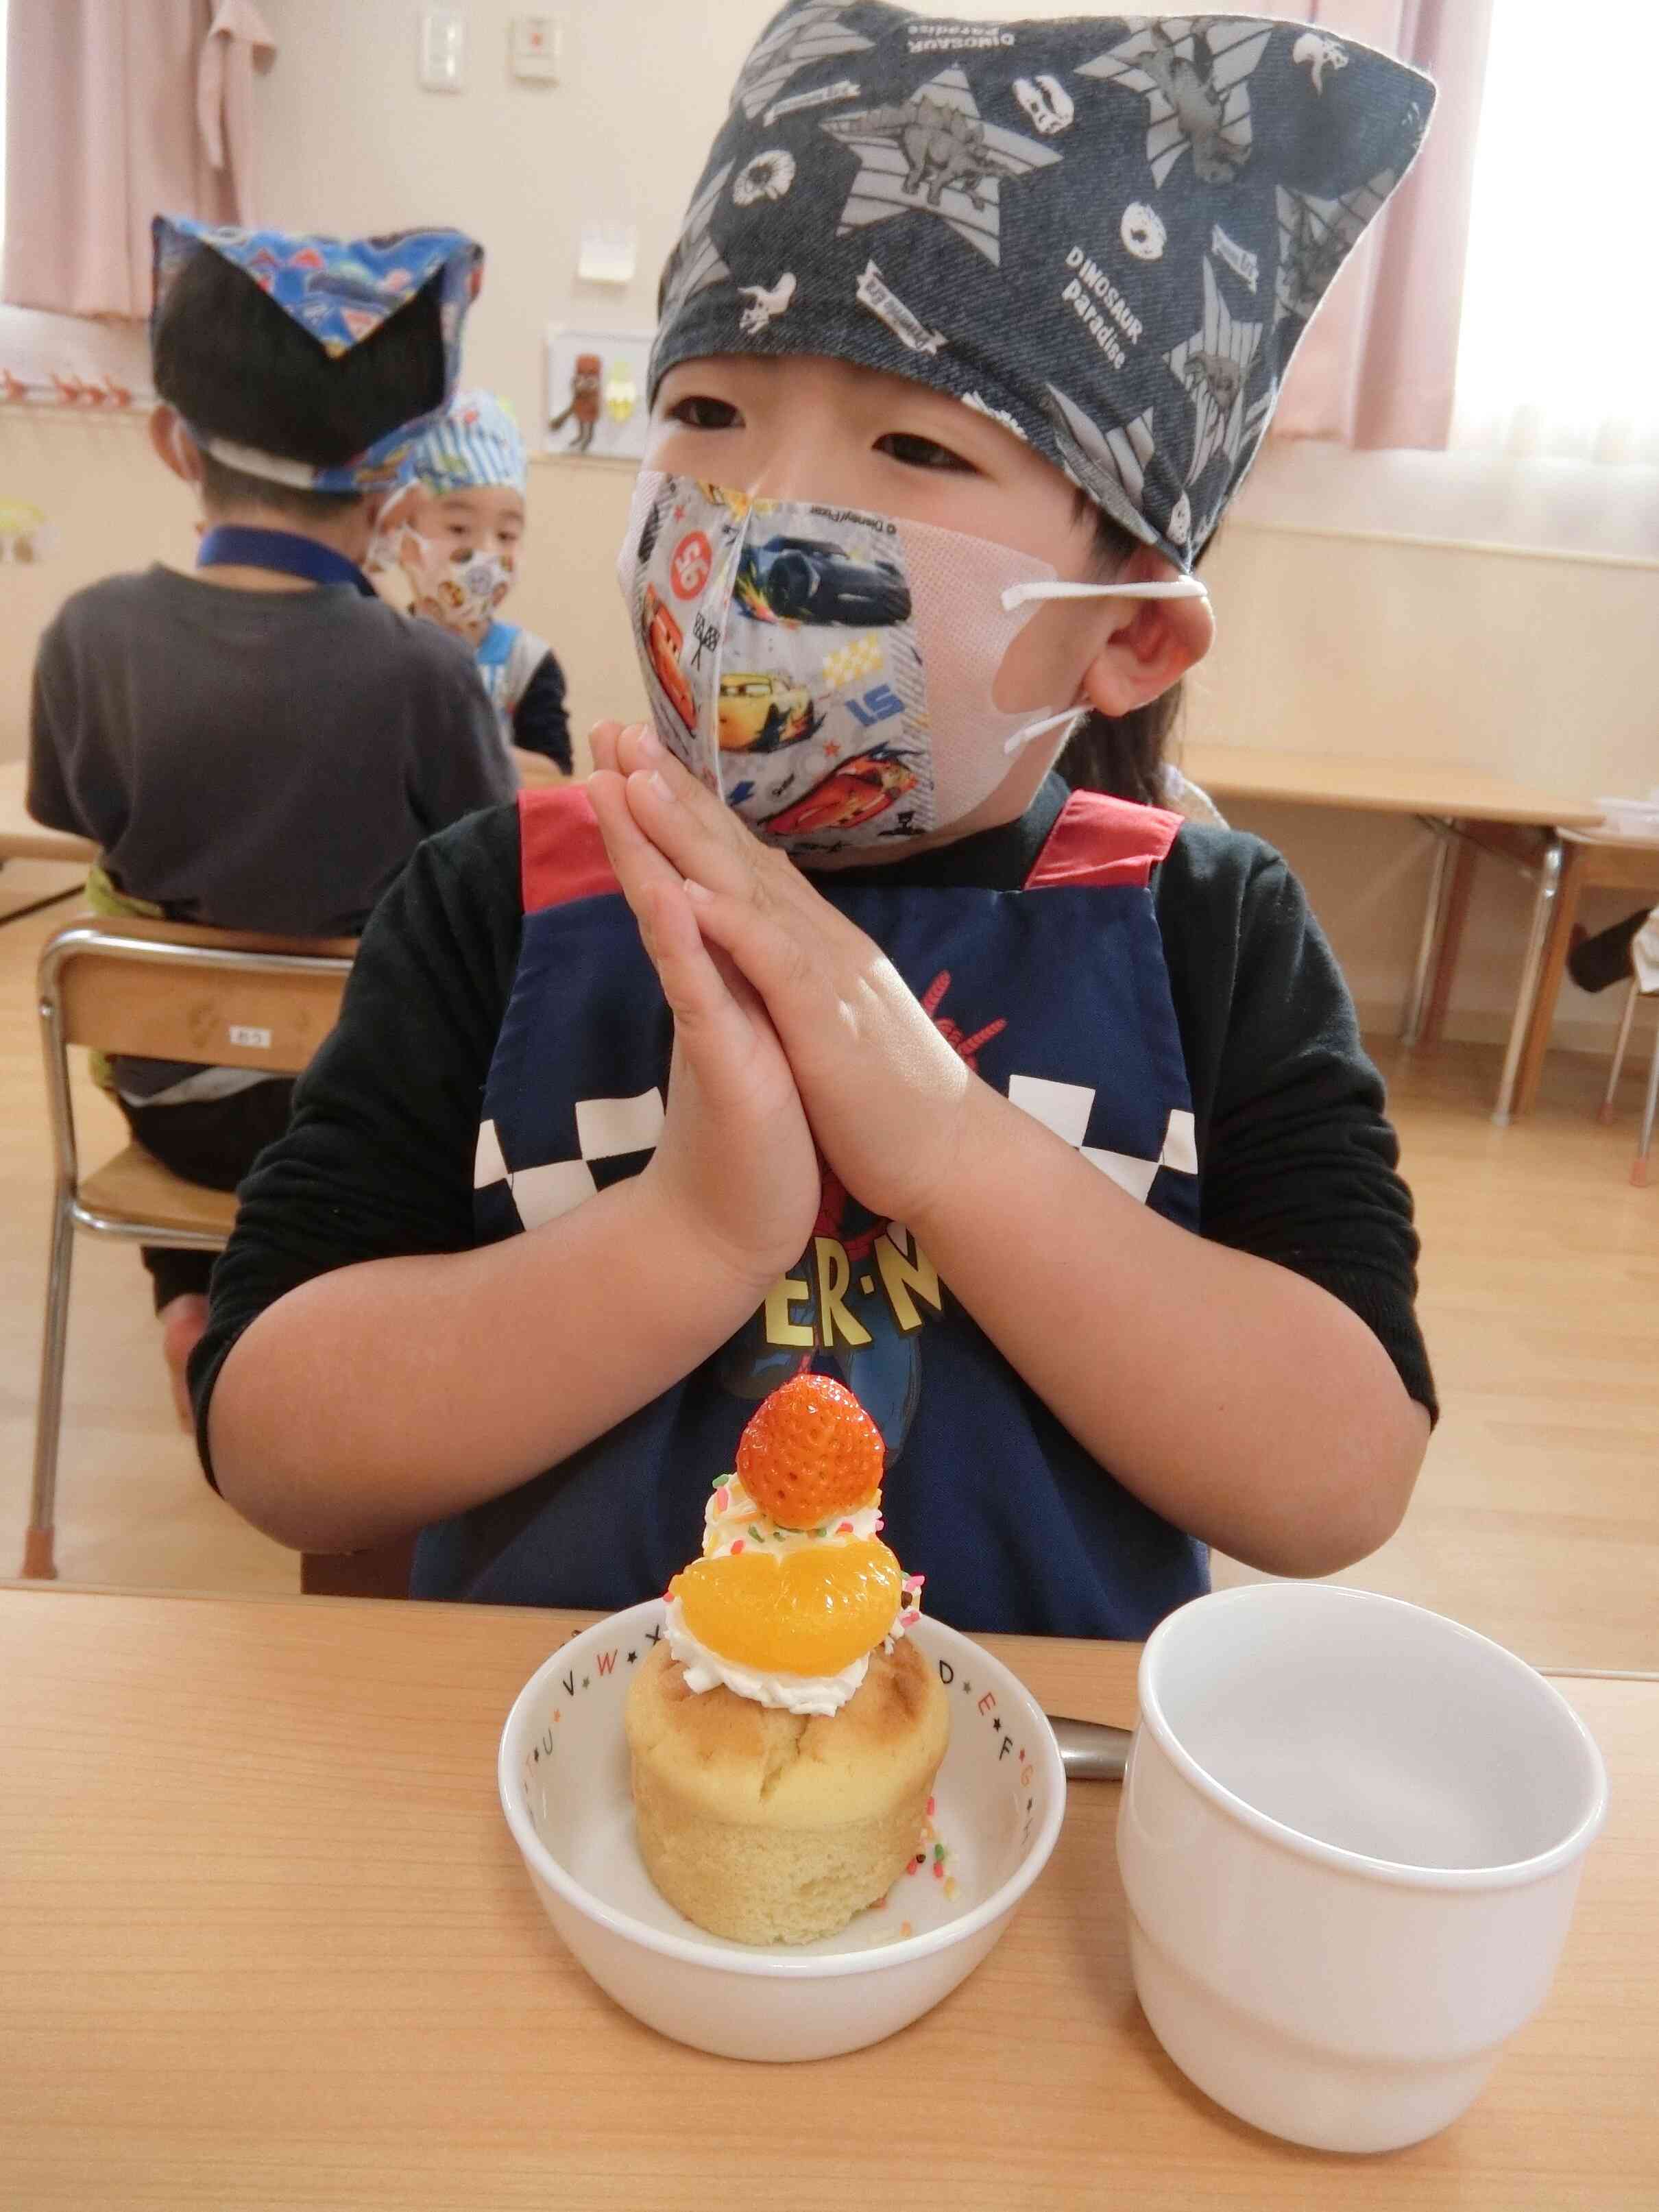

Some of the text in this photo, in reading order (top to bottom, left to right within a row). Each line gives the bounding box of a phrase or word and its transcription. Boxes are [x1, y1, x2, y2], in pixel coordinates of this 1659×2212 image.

[907, 34, 1015, 53] DINOSAUR
[1065, 245, 1143, 344] DINOSAUR
[561, 1670, 575, 1696] V
[596, 1648, 619, 1676] W
[939, 1659, 954, 1685] D
[977, 1692, 997, 1716] E
[999, 1735, 1014, 1762] F
